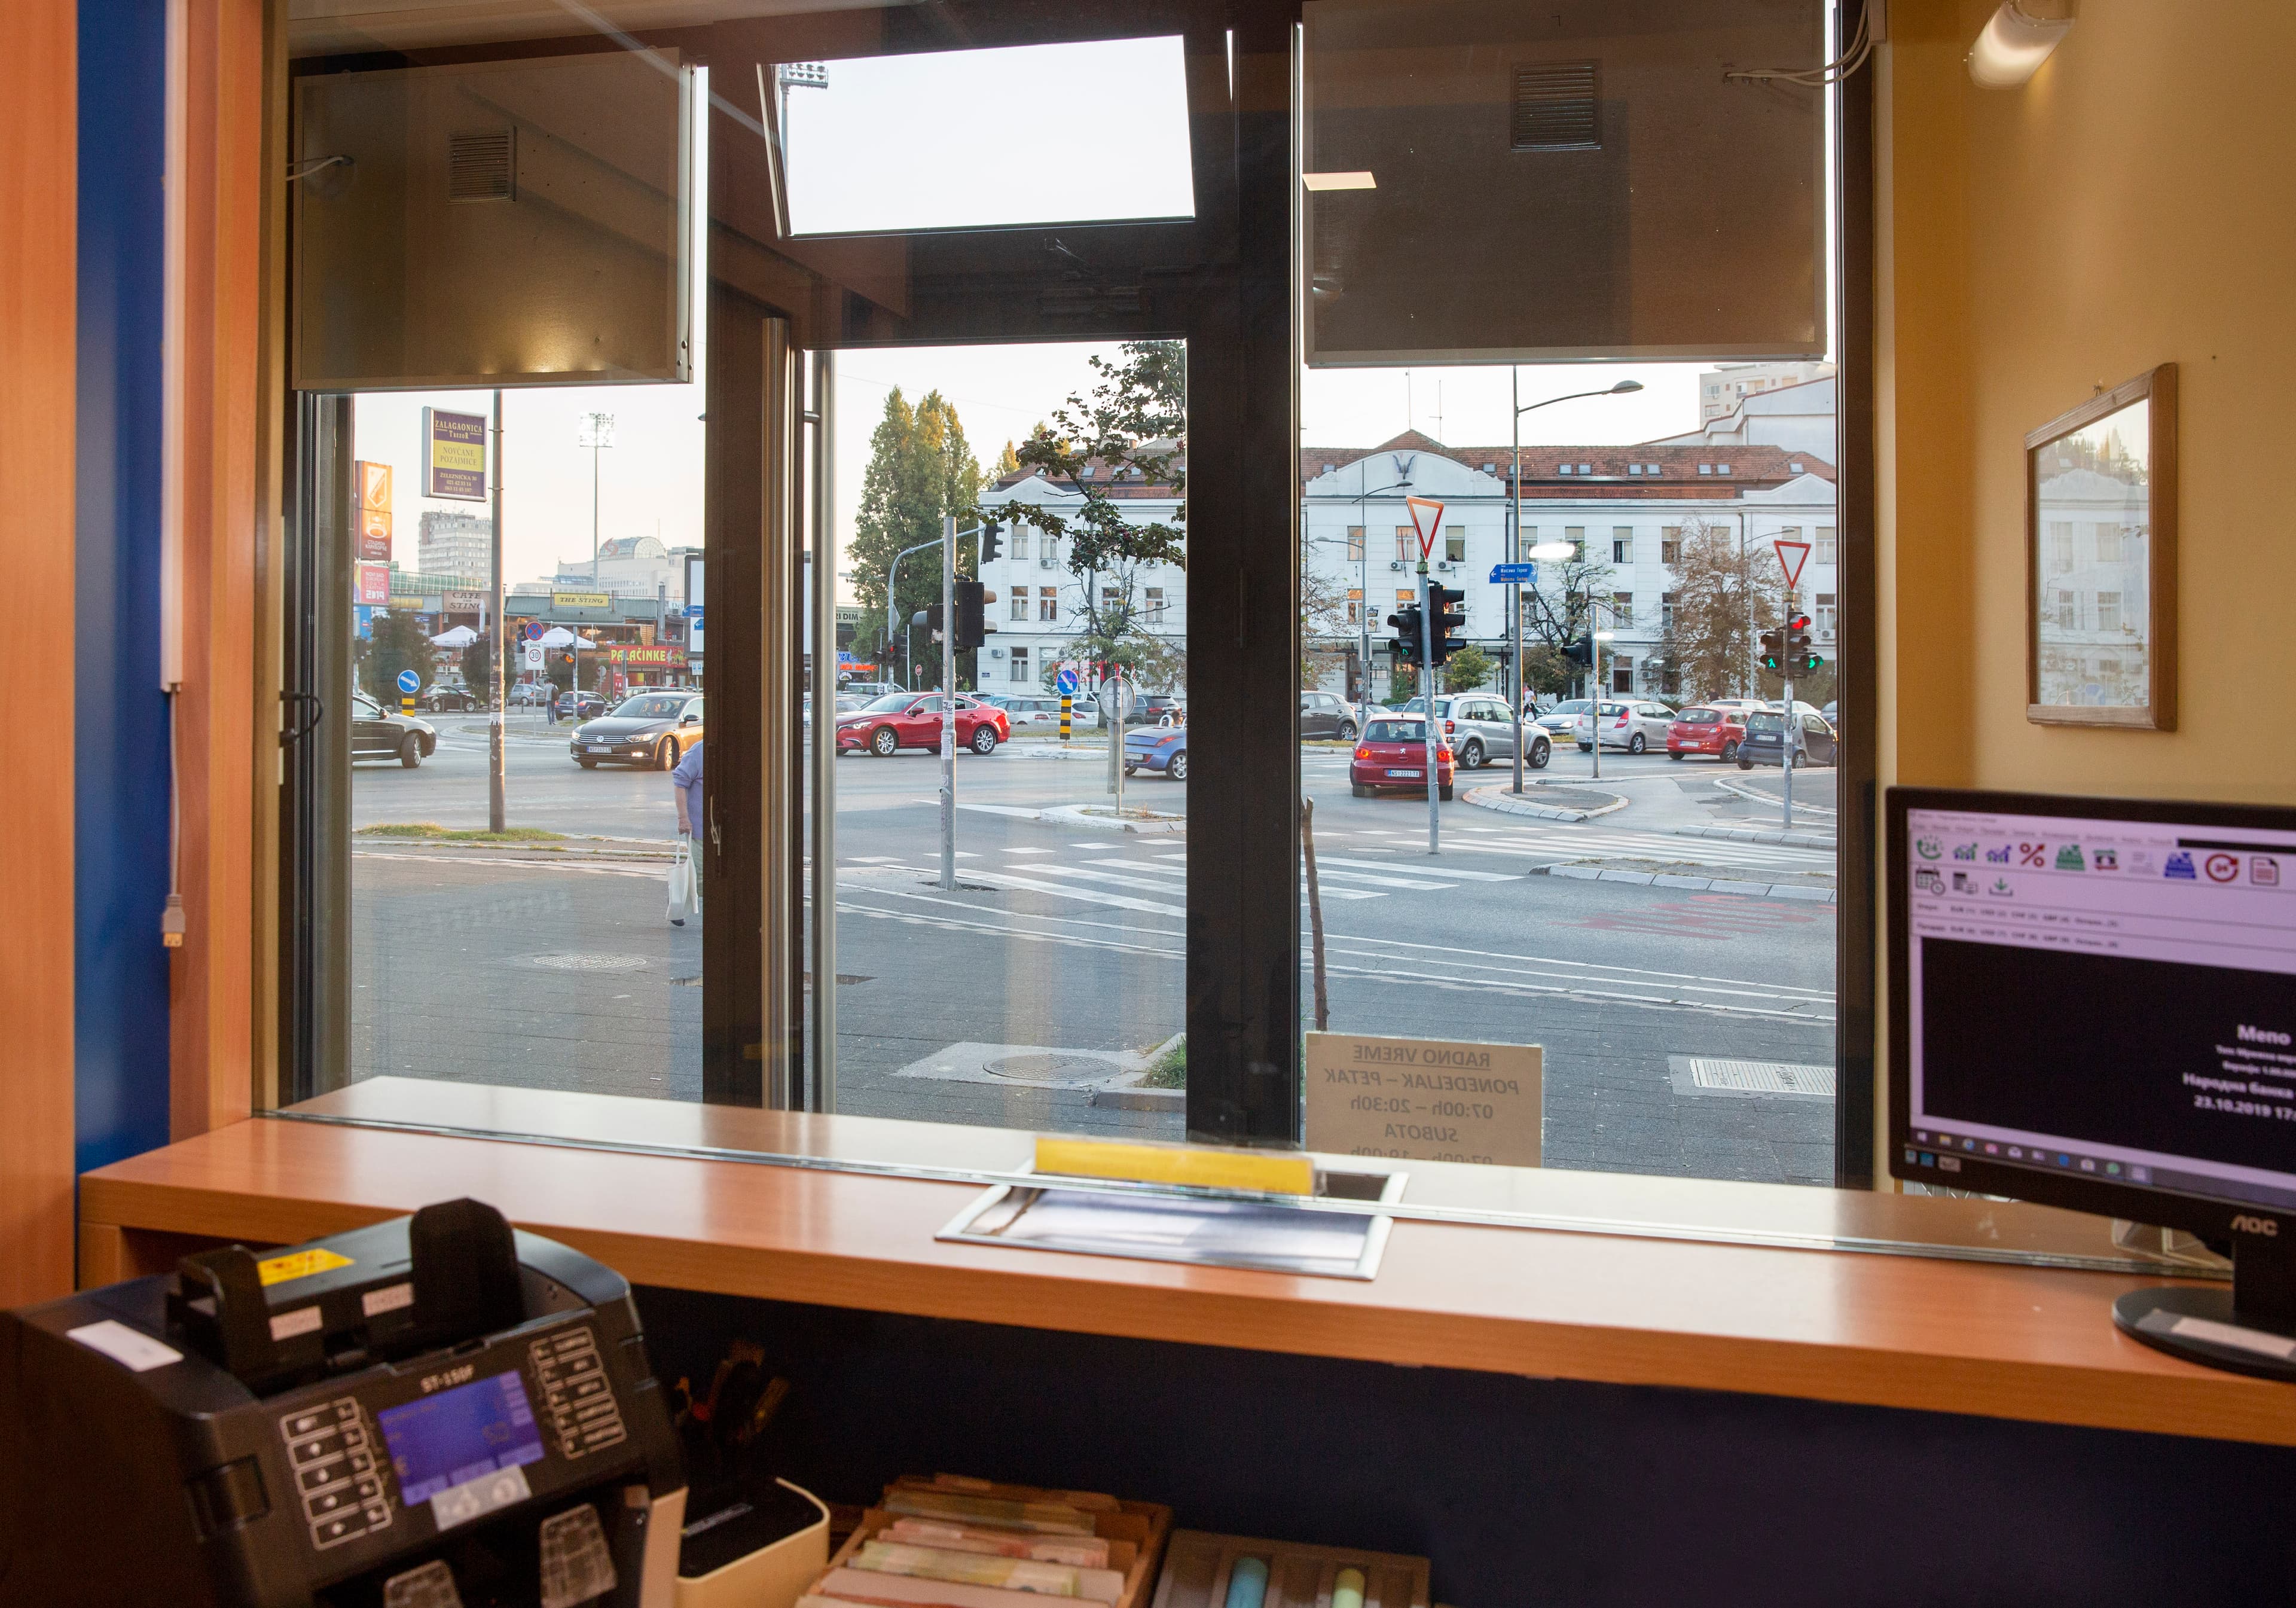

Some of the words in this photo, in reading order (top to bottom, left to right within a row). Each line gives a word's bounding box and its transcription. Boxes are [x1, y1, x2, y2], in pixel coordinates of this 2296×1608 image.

[435, 420, 483, 433] ZALAGAONICA
[443, 446, 474, 457] NOVČANE
[440, 455, 478, 466] POZAJMICE
[611, 648, 665, 662] PAAČINKE
